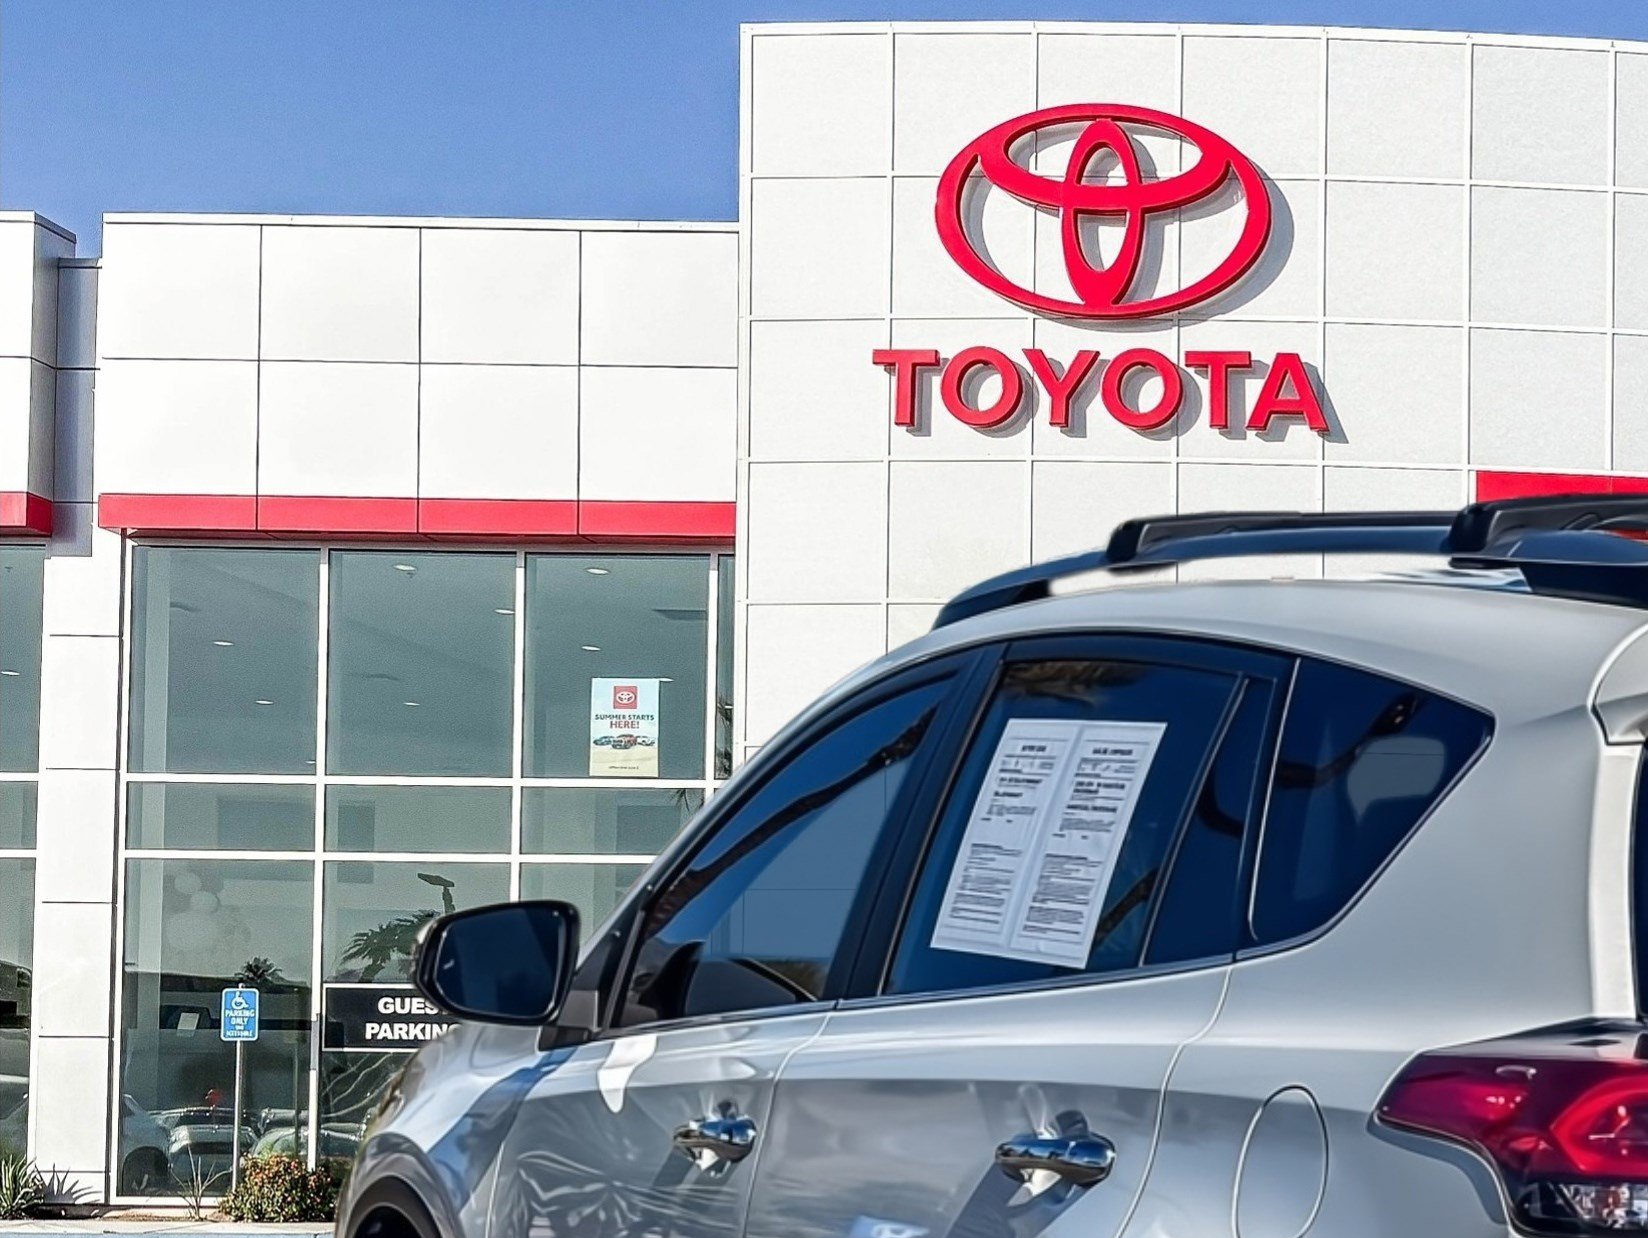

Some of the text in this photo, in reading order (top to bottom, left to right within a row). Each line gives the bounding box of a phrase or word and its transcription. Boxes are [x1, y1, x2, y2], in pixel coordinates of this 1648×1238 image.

[873, 346, 1329, 432] TOYOTA
[609, 720, 640, 729] HERE!
[377, 997, 450, 1014] GUES
[365, 1022, 464, 1040] PARKIN
